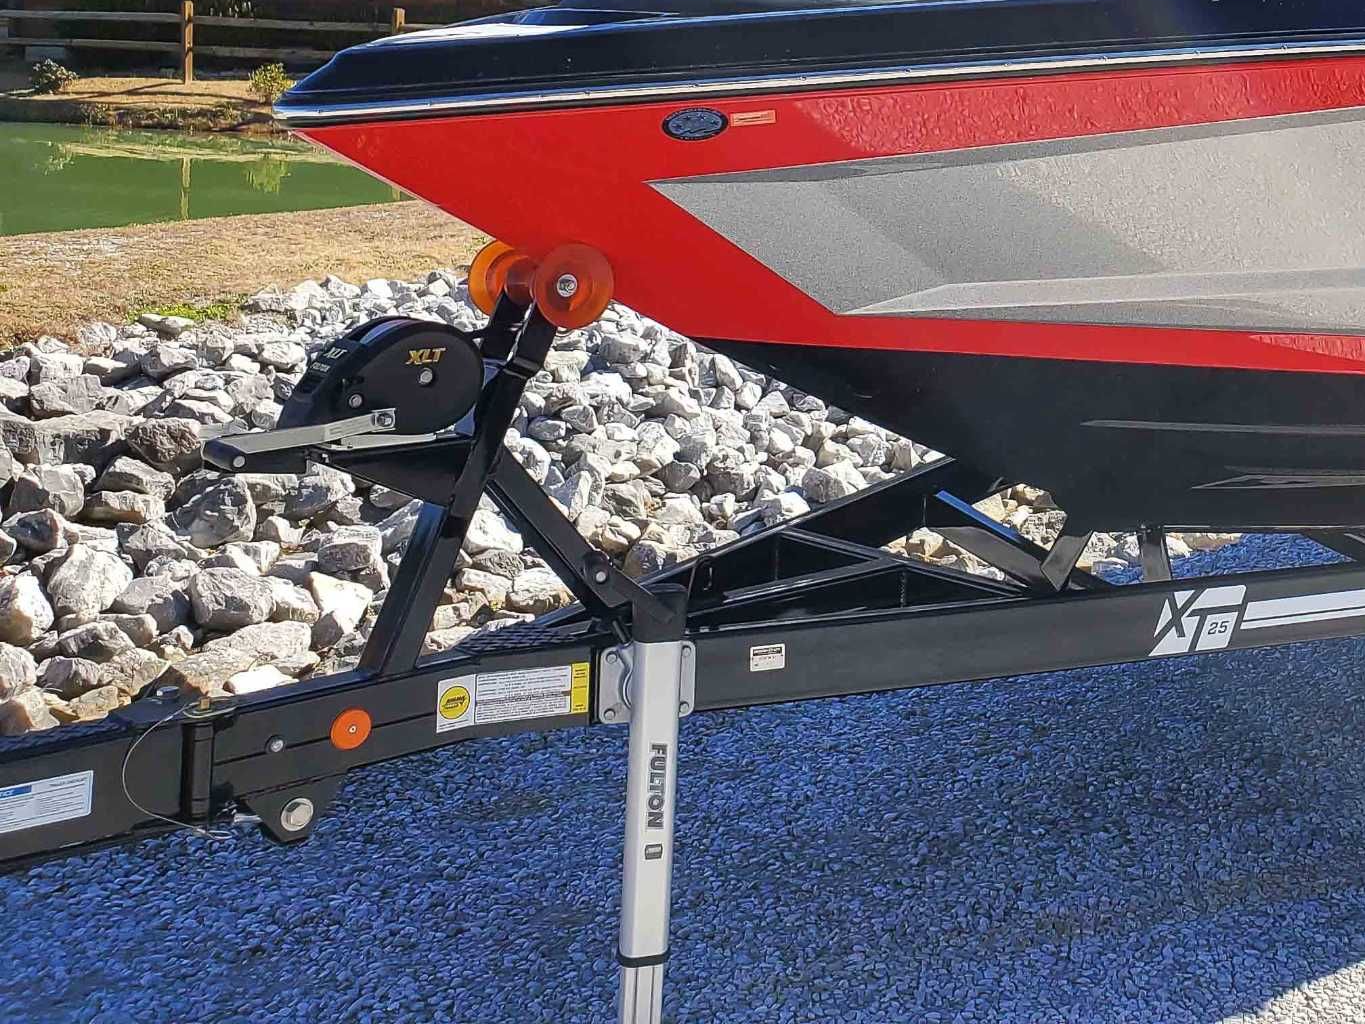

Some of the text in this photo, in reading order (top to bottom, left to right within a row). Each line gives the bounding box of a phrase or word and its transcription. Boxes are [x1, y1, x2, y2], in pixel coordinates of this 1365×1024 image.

[405, 347, 446, 365] XLT
[1207, 620, 1230, 635] 25
[647, 743, 668, 829] FULTON
